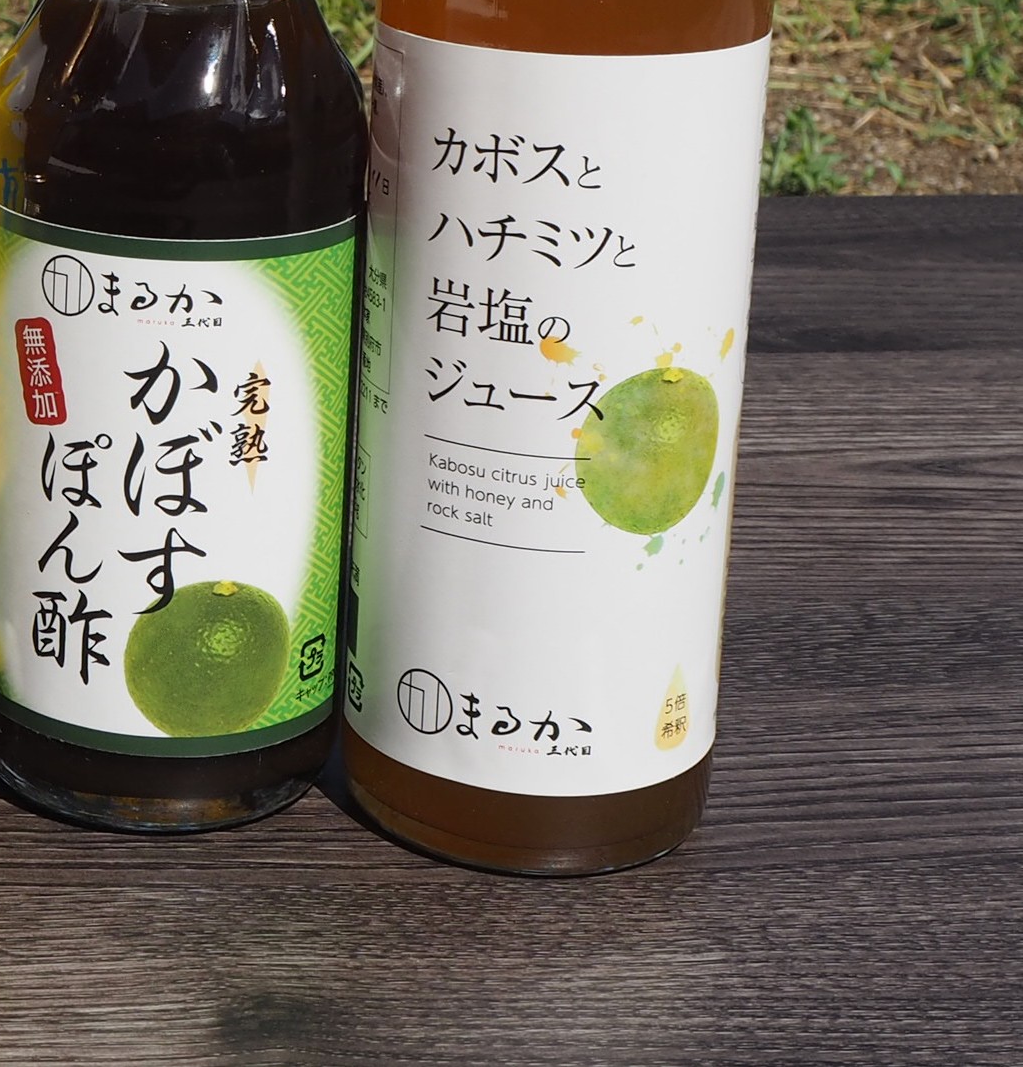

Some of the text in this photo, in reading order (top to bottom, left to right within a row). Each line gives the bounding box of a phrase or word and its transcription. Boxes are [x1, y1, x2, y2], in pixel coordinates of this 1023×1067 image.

[431, 127, 603, 190] カボスと
[427, 212, 637, 270] ハチミツと
[97, 271, 224, 317] まるか
[426, 276, 571, 346] 岩塩の
[180, 315, 223, 328] 三代目
[21, 324, 59, 419] 無添加
[424, 355, 605, 421] ジュース
[230, 372, 272, 467] 完熟
[117, 339, 224, 615] かぼす
[427, 477, 554, 511] with honey and
[428, 452, 587, 491] Kabosu citrus juice
[427, 500, 494, 527] rock salt
[31, 431, 114, 686] ぽん酢
[455, 692, 593, 741] まるか
[660, 715, 687, 740] 希釈
[664, 693, 687, 715] 5倍
[546, 743, 592, 757] 三代目
